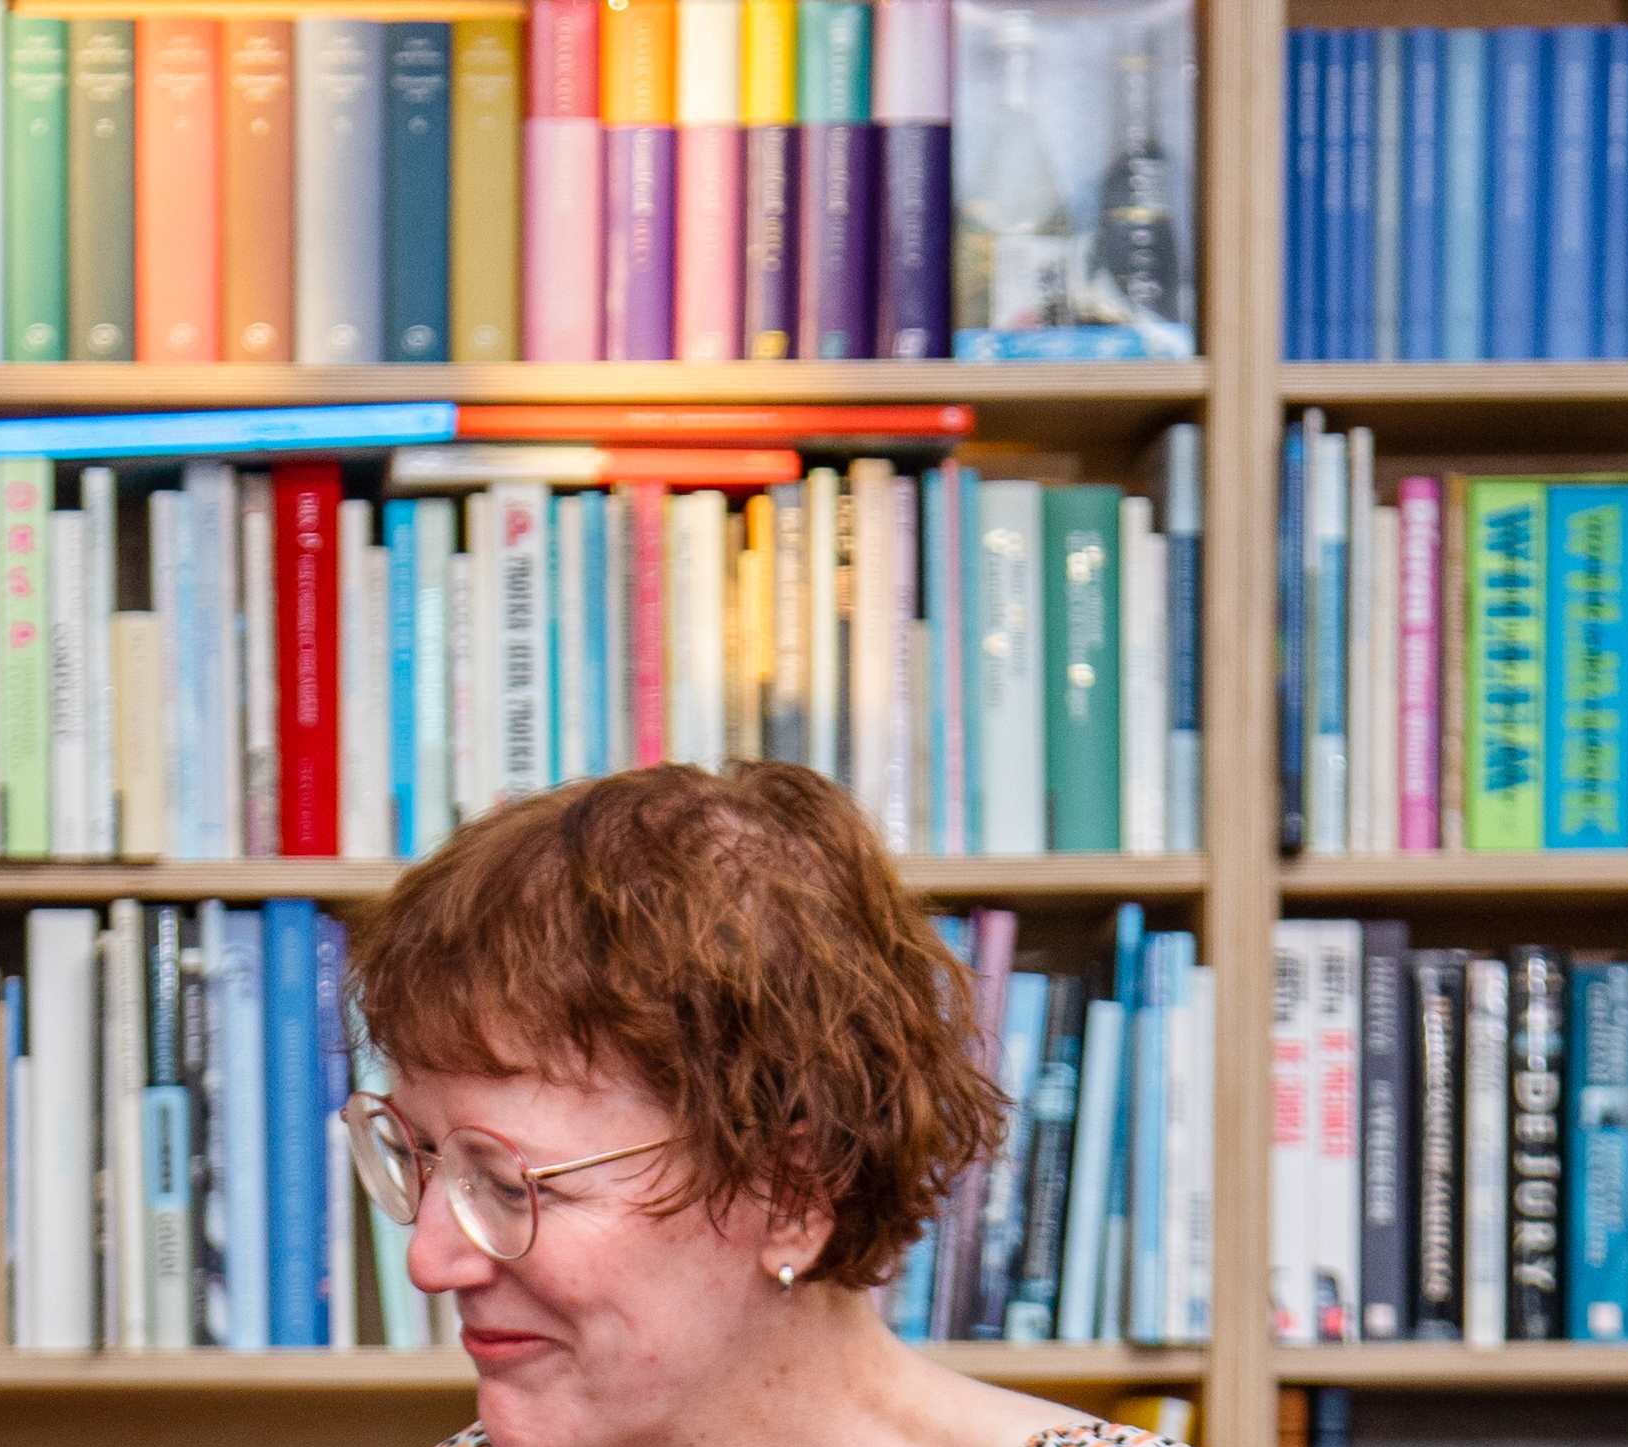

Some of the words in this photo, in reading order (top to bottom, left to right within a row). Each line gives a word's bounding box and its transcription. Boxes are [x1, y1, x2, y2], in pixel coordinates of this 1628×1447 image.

[1481, 503, 1539, 795] WILLEM
[1514, 1070, 1558, 1136] DE
[1513, 1151, 1559, 1295] JURY
